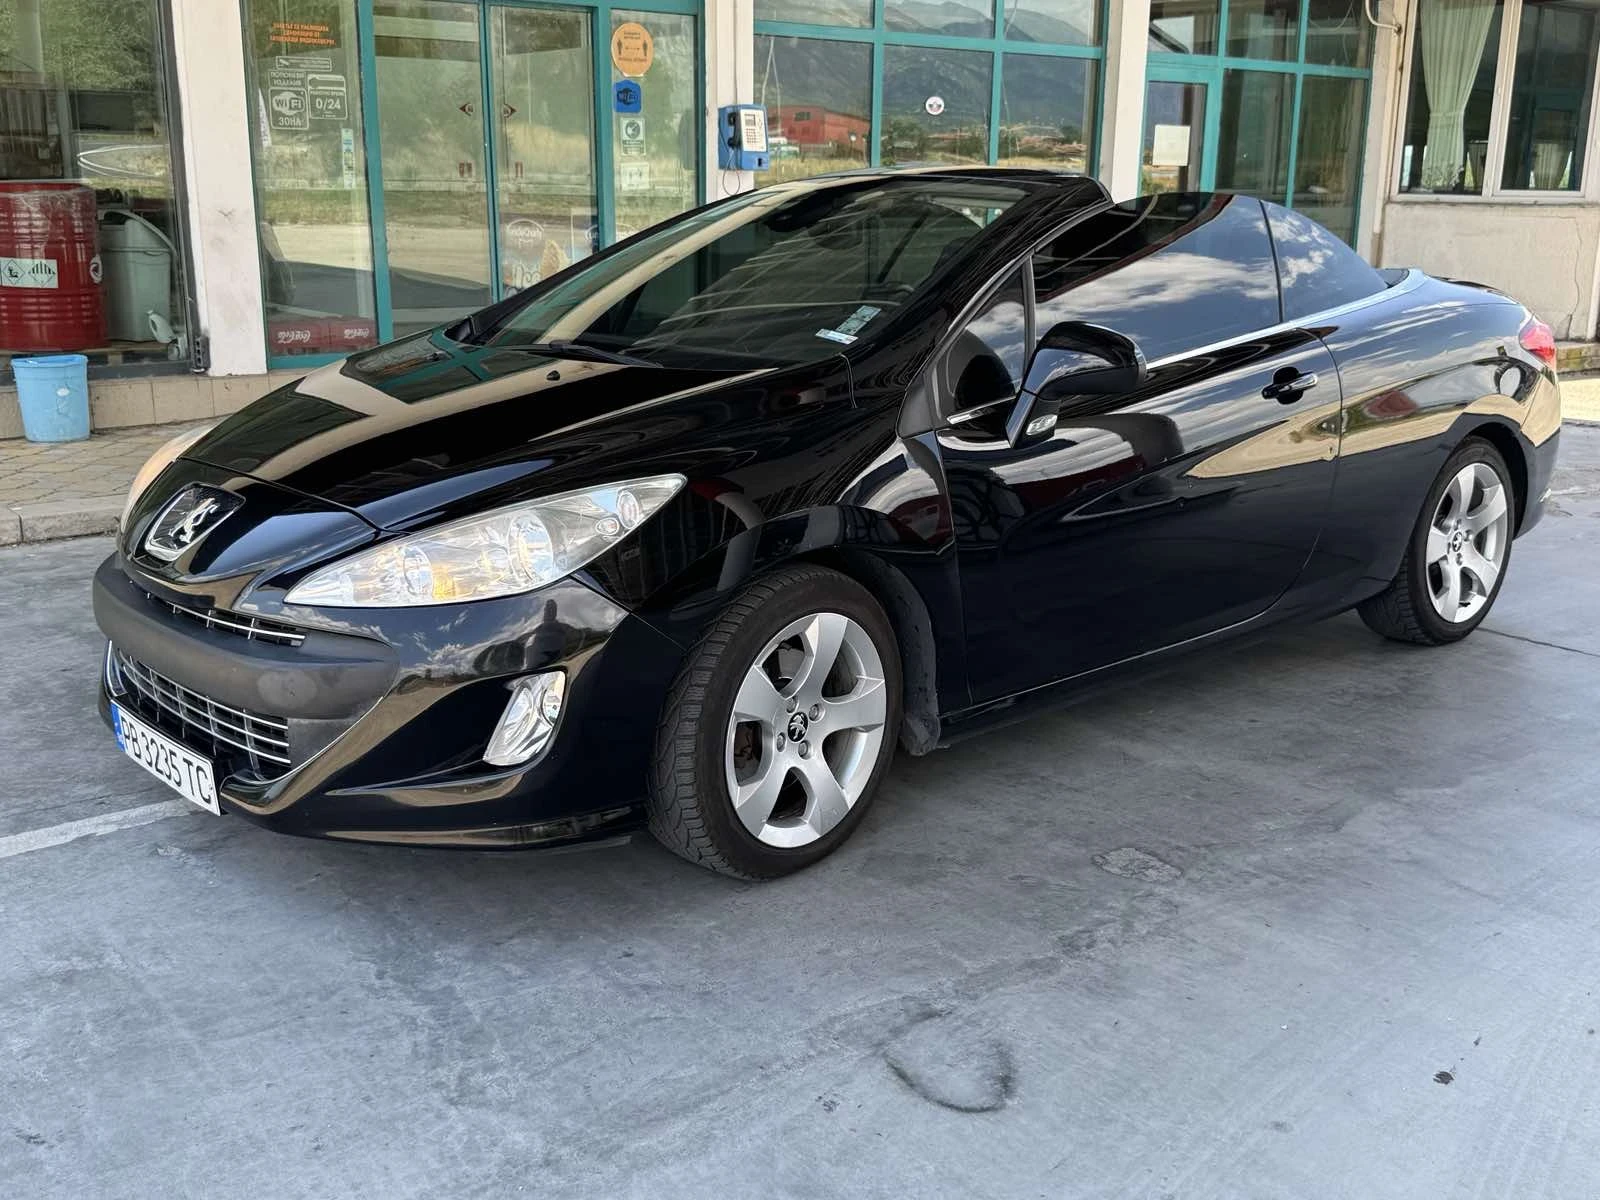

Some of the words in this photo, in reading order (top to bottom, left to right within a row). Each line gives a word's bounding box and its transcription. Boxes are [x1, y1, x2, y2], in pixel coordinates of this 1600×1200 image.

[315, 96, 341, 111] 0/24
[141, 731, 182, 788] 3235
[182, 757, 212, 804] TC
